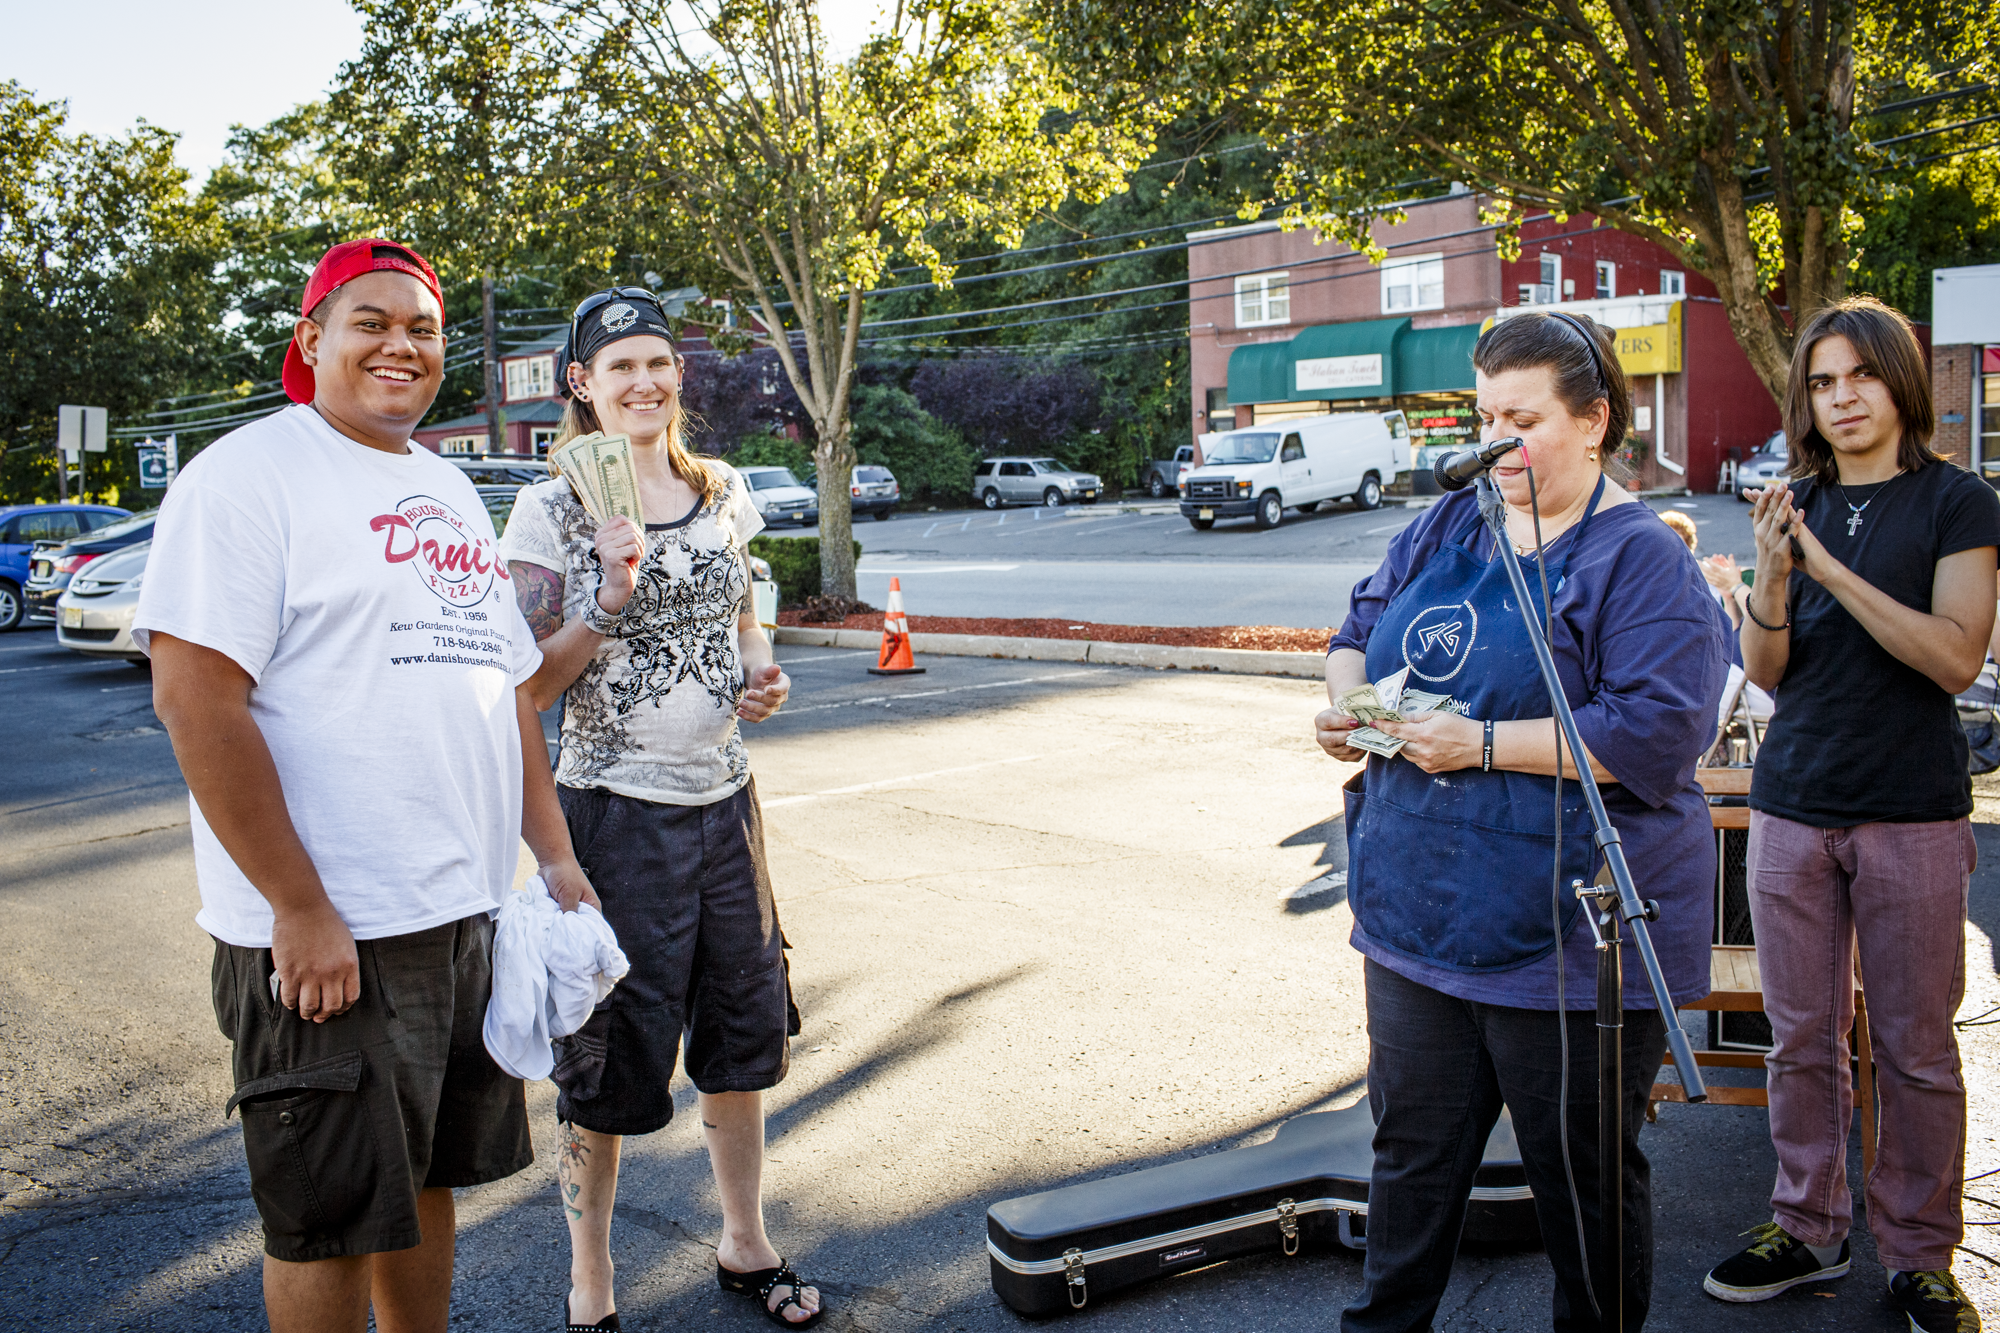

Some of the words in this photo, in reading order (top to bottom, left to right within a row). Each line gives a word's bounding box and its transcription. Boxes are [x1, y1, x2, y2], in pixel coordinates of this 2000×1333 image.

[1309, 363, 1345, 377] Italian
[1348, 359, 1377, 374] Touch
[404, 505, 447, 522] HOUSE
[450, 517, 464, 529] of
[429, 575, 481, 599] PIZZA
[463, 611, 488, 621] 1959
[390, 622, 413, 632] Kew
[416, 620, 454, 632] Gardens
[455, 625, 489, 637] Original
[433, 636, 502, 655] 718-846-2849
